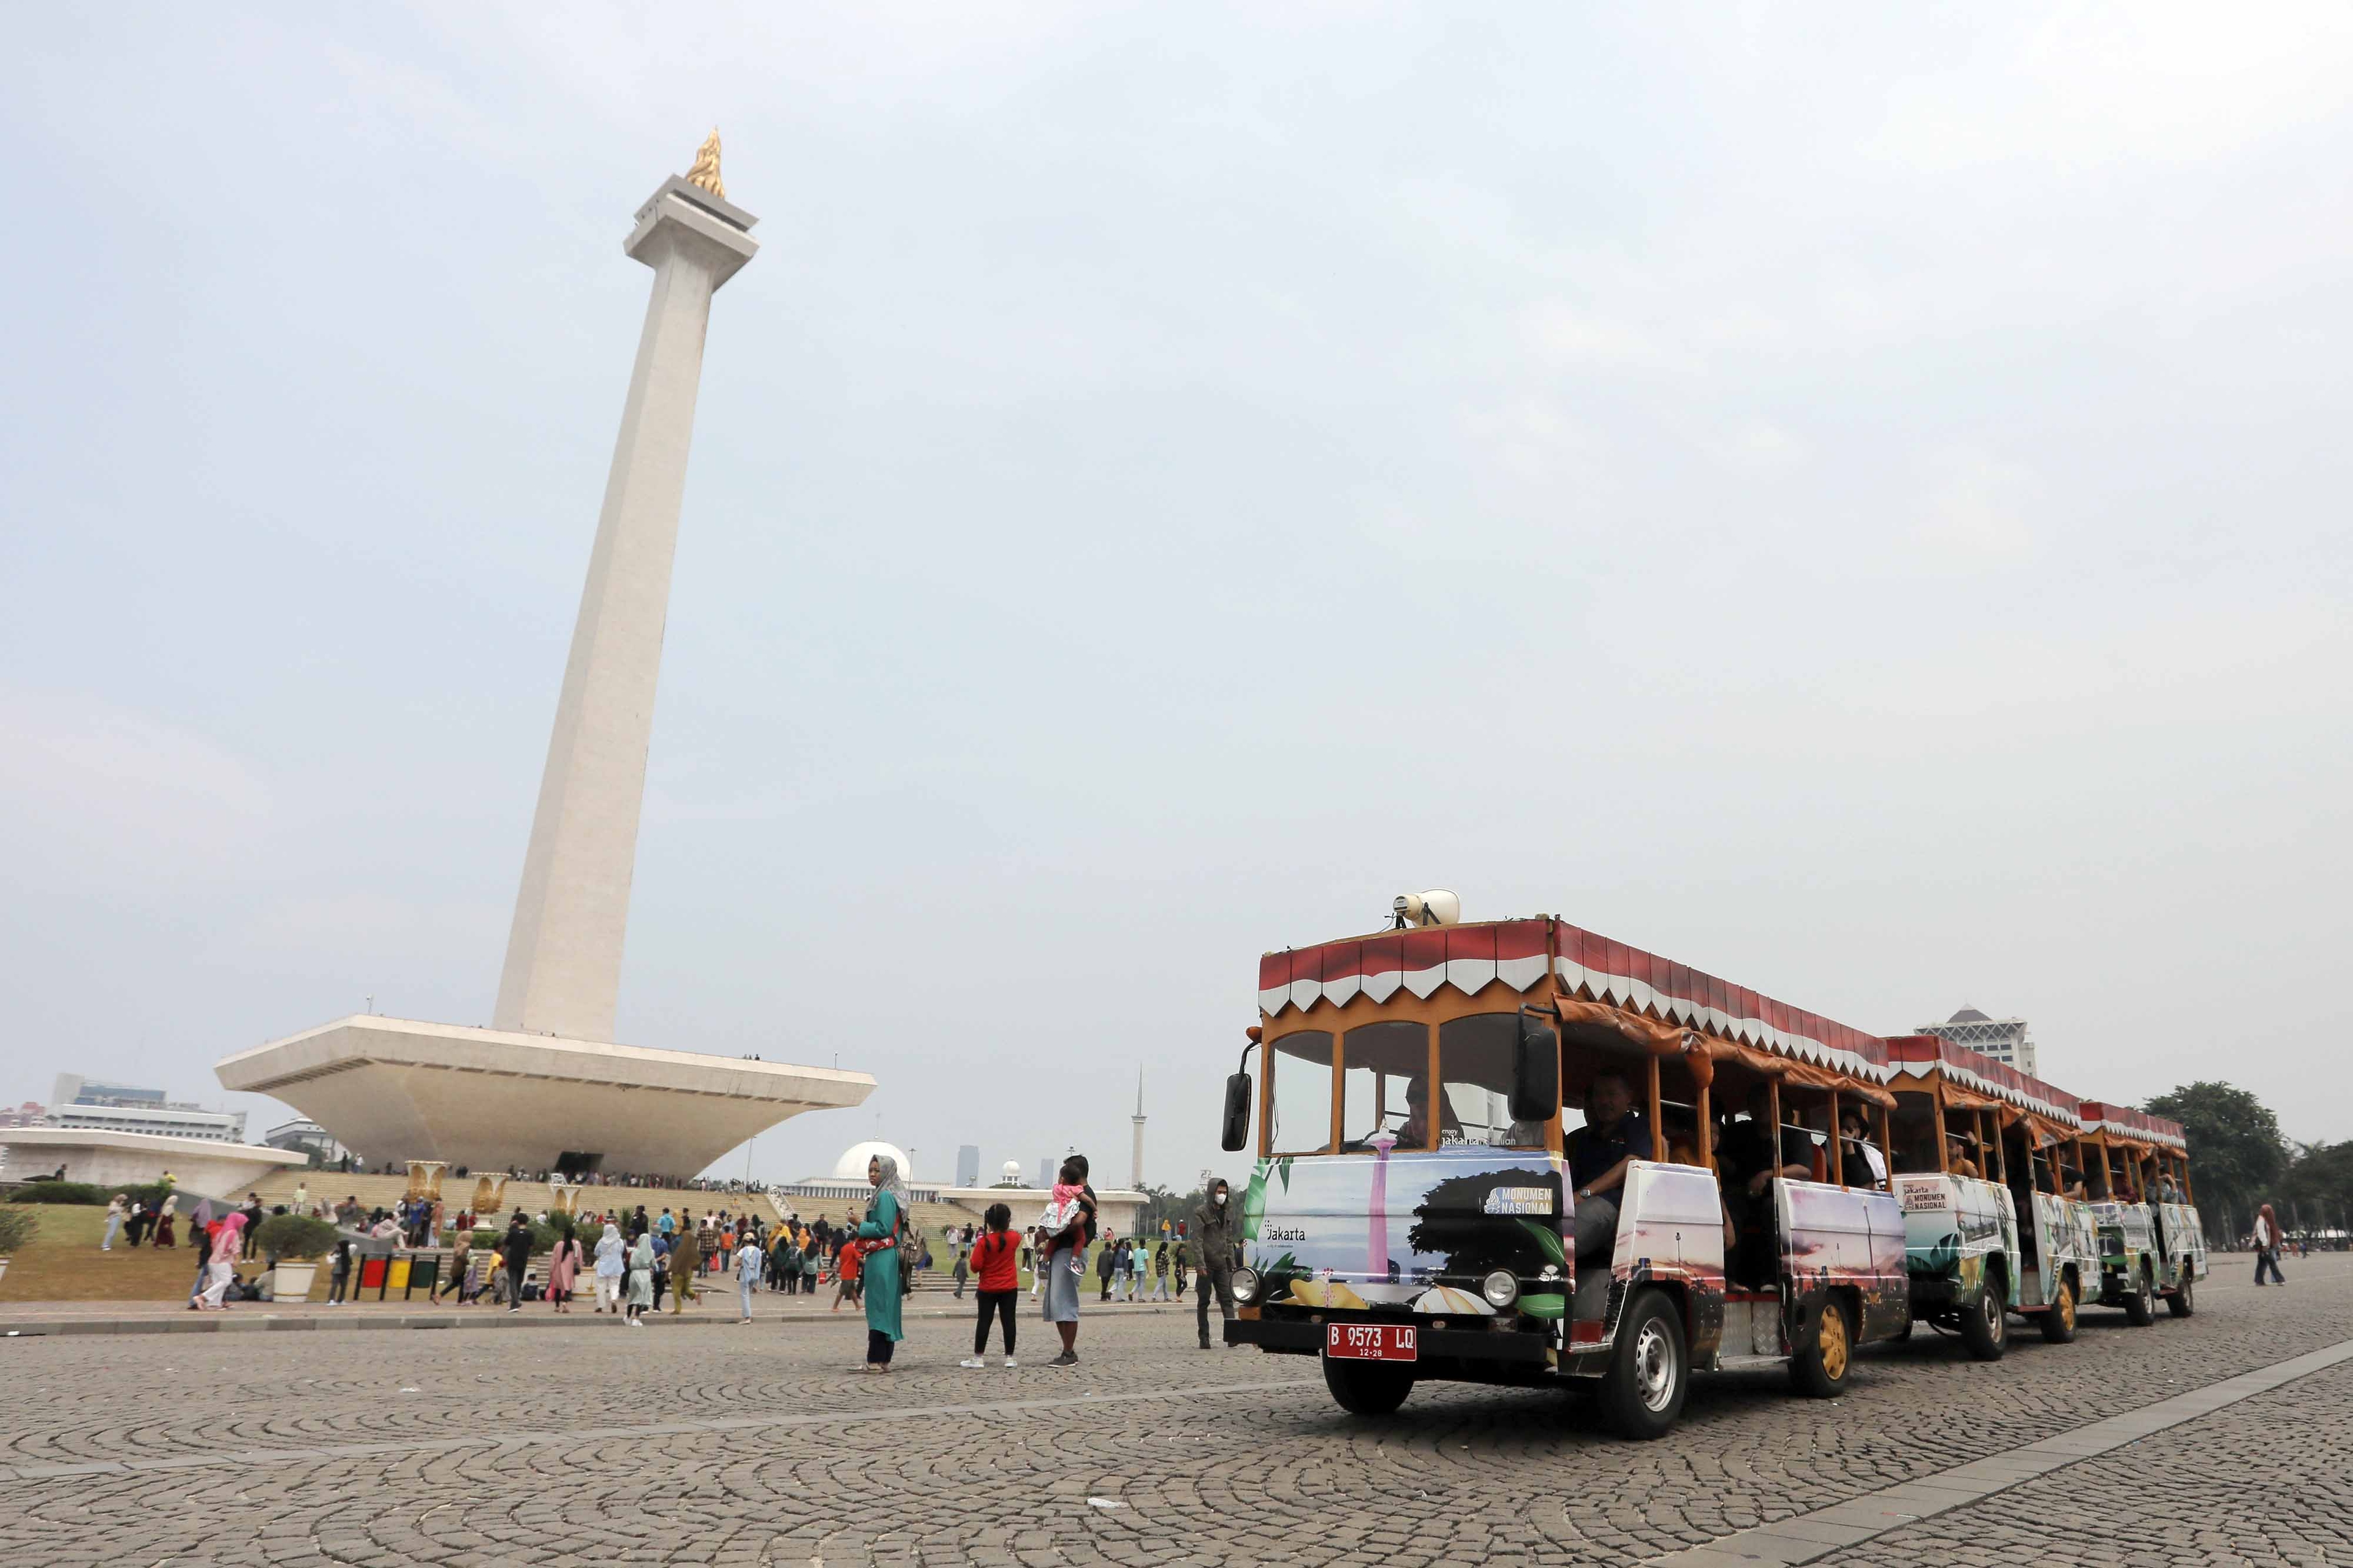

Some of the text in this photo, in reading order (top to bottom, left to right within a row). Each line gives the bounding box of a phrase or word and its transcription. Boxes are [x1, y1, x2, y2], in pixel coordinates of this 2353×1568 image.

[1502, 1188, 1551, 1200] MONUMEN
[1501, 1202, 1552, 1214] NASIONAL
[1267, 1226, 1306, 1241] Jakarta
[1331, 1326, 1414, 1349] B 9573 LQ
